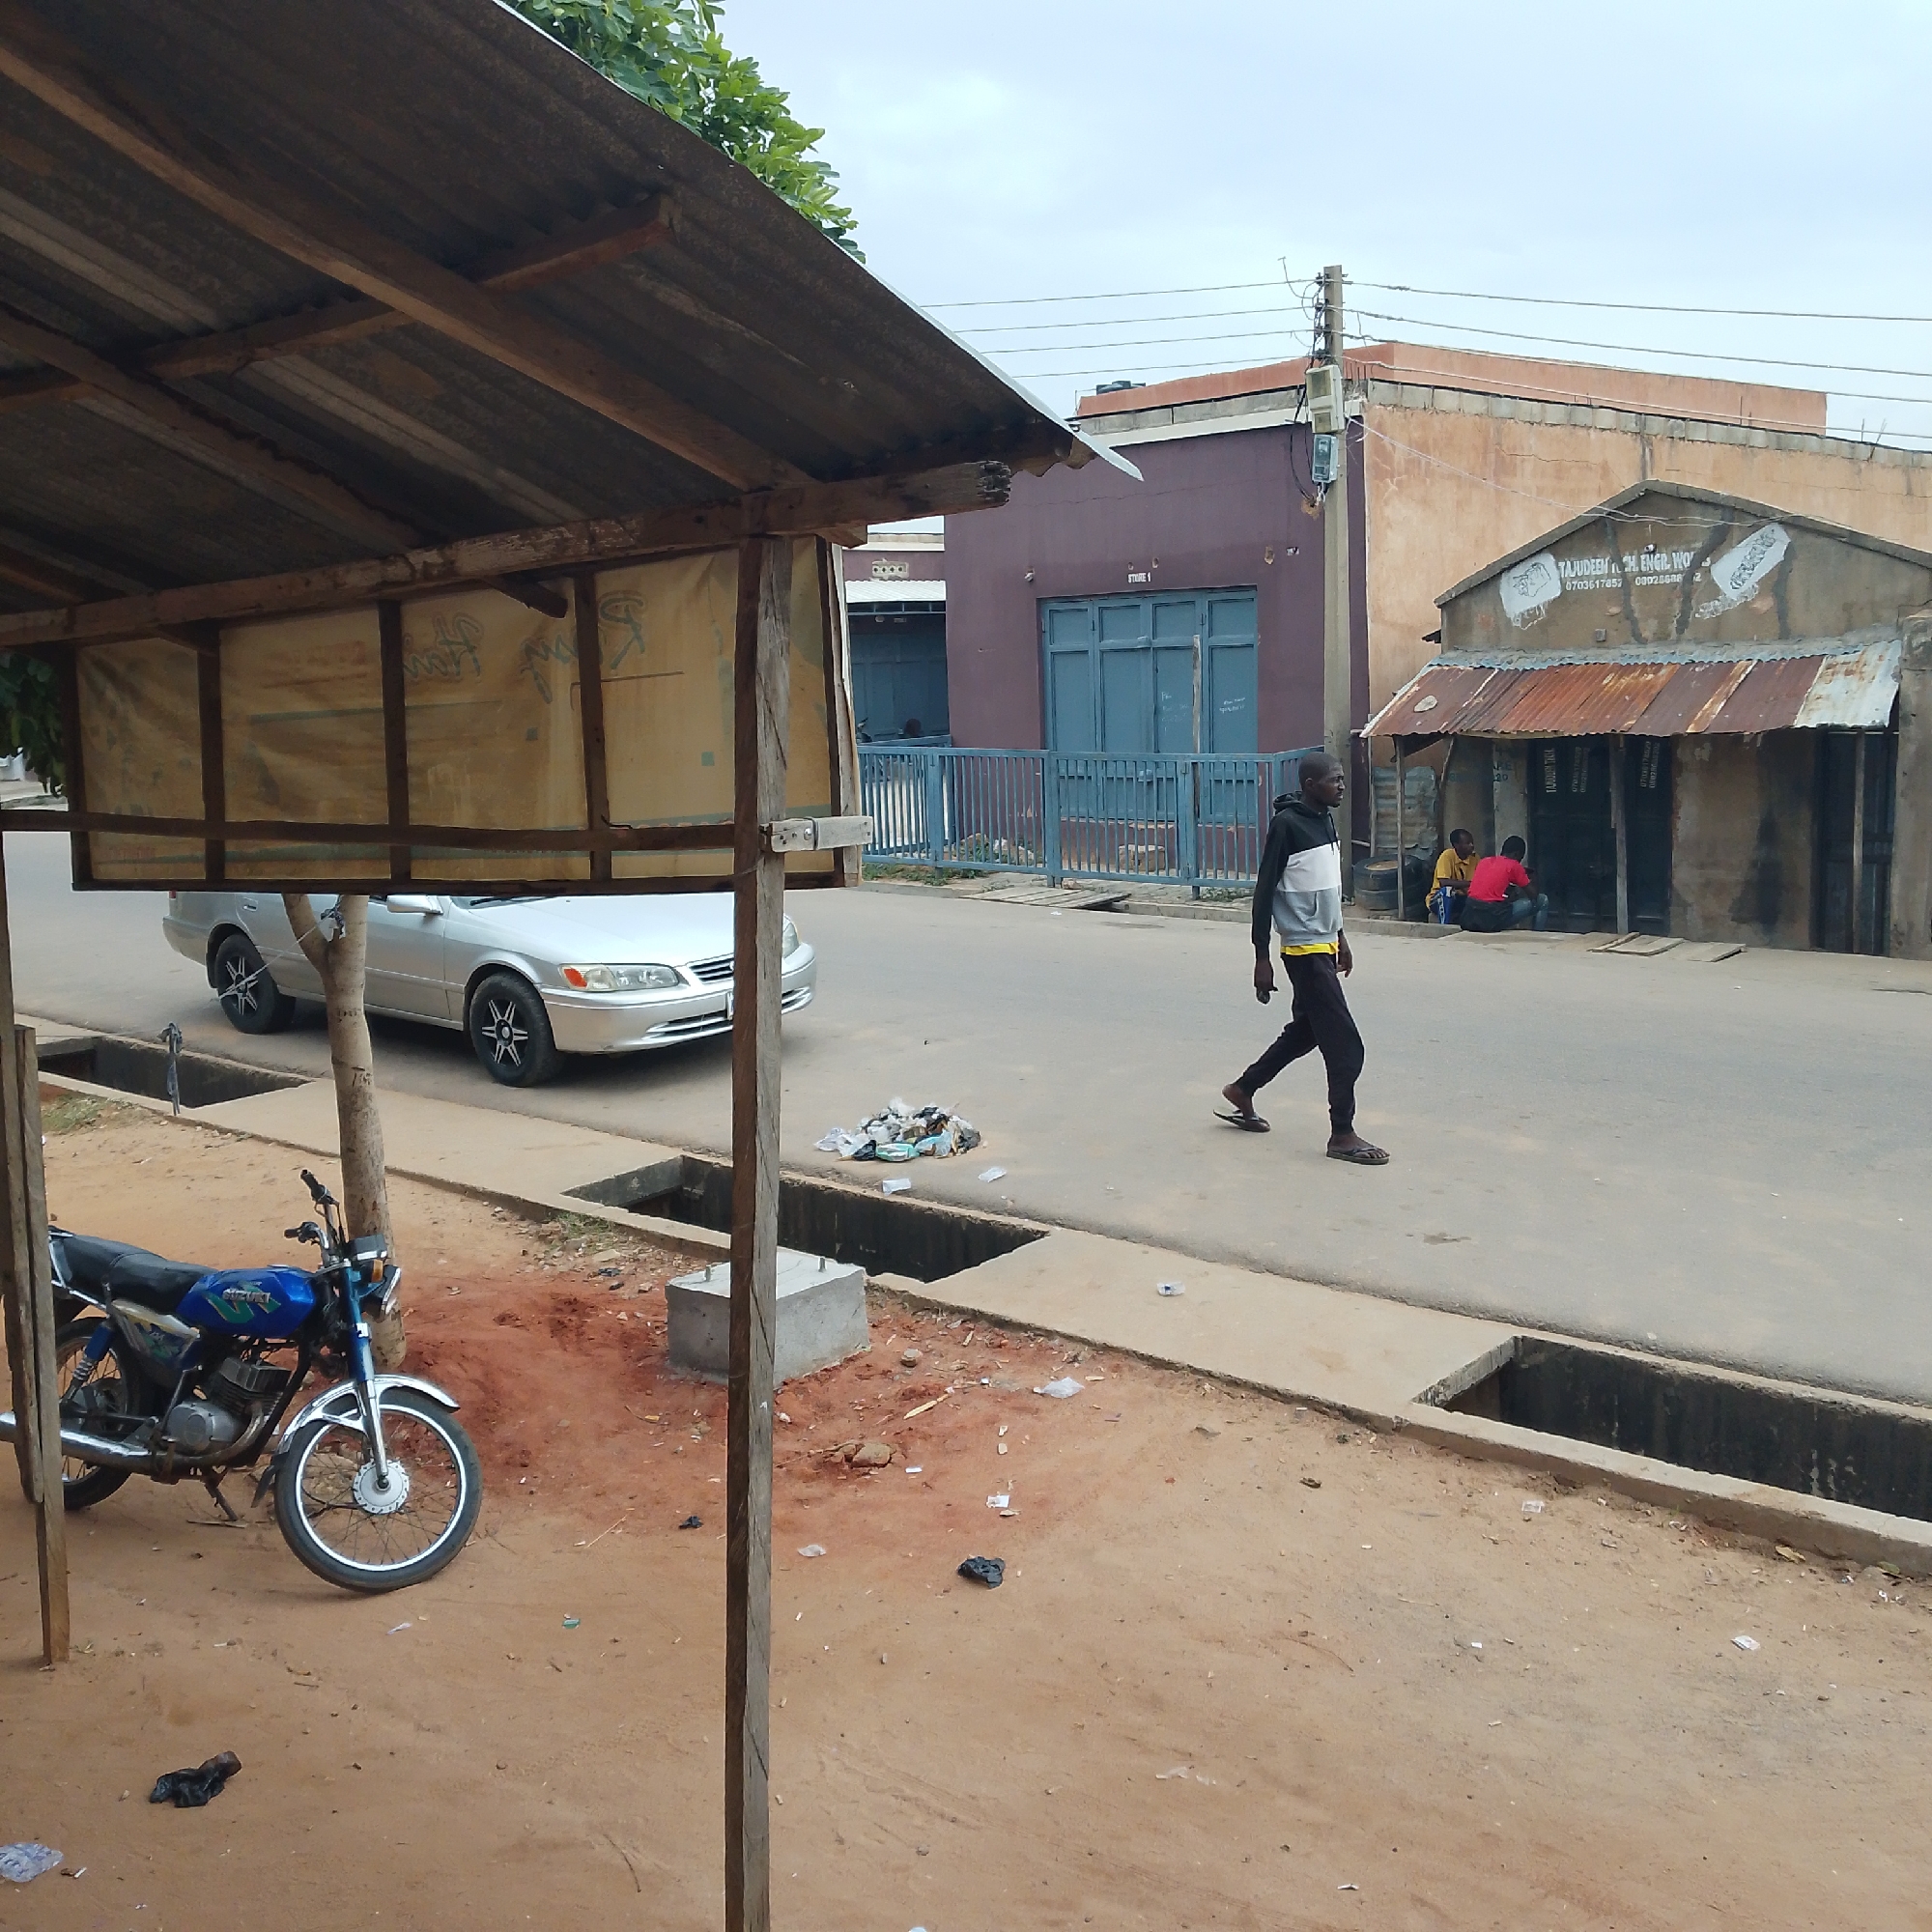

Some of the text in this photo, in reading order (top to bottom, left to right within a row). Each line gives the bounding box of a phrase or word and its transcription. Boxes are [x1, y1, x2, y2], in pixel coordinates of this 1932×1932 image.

[1558, 557, 1608, 578] TAJUDEEN
[1127, 572, 1147, 583] STORE
[1565, 578, 1623, 590] 0703617852
[222, 1288, 271, 1304] SUZUKI
